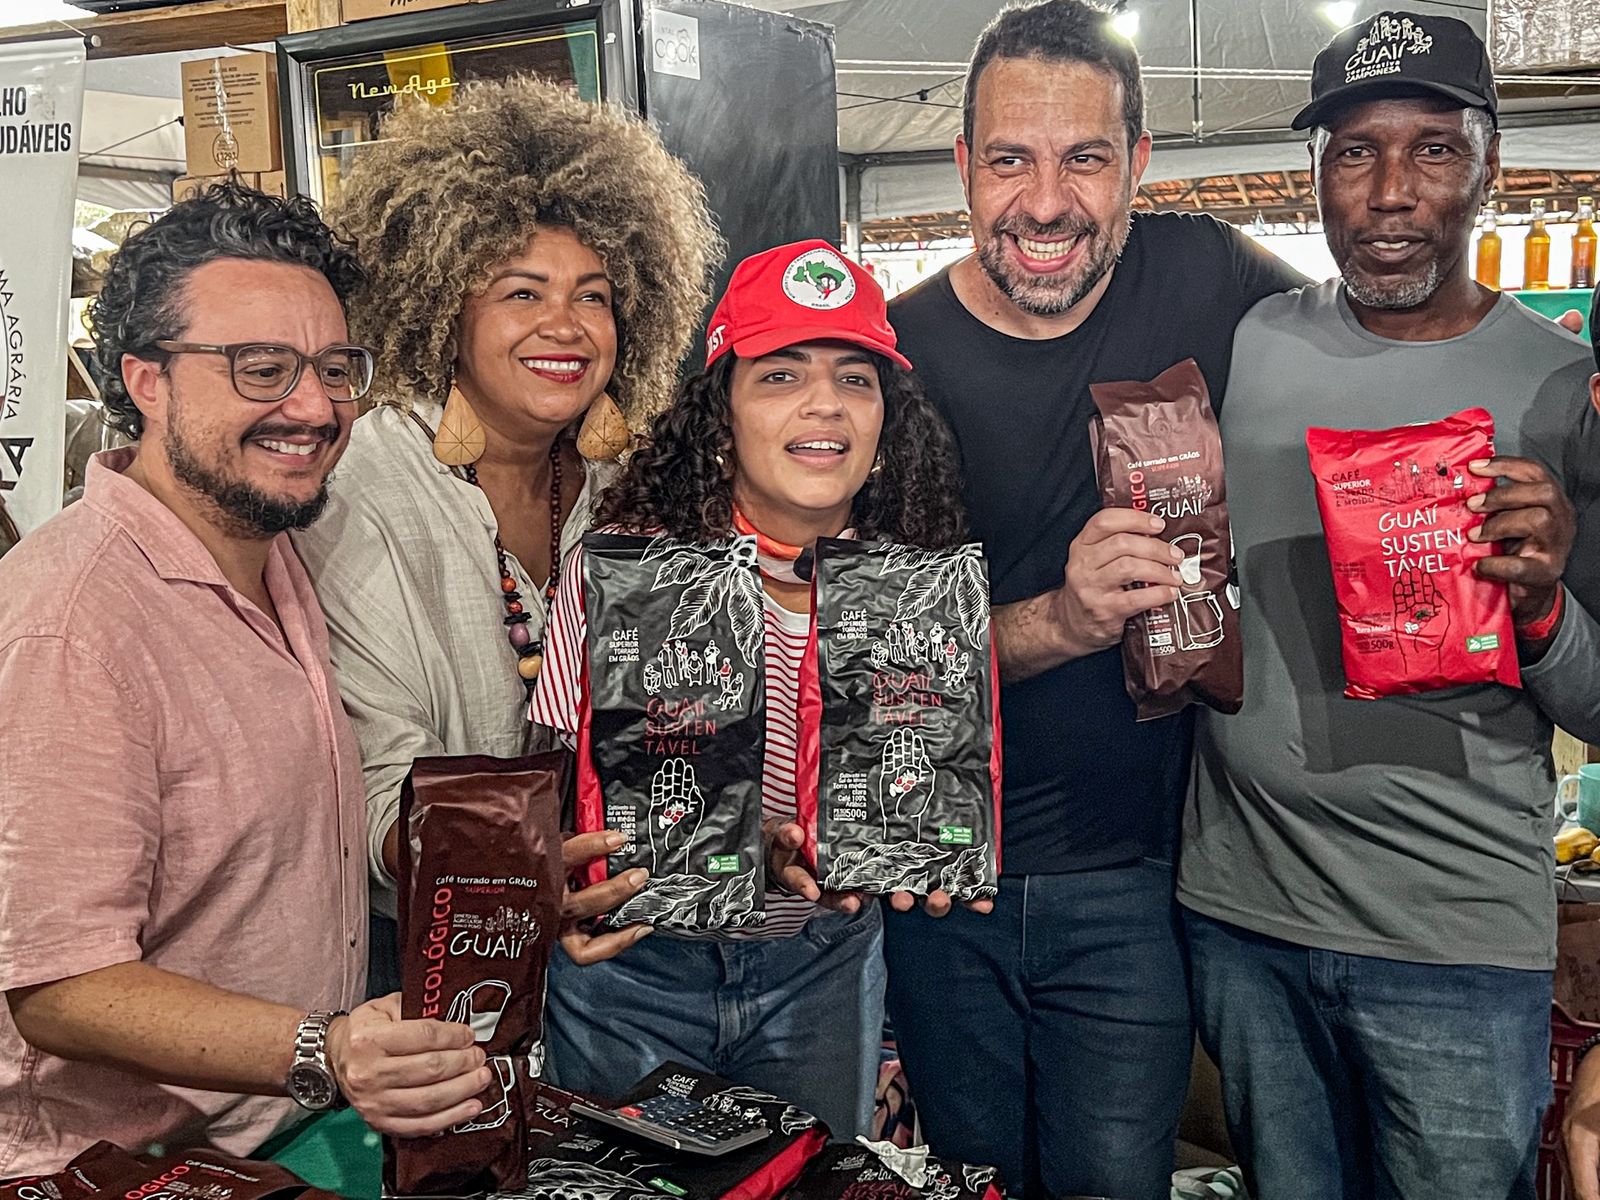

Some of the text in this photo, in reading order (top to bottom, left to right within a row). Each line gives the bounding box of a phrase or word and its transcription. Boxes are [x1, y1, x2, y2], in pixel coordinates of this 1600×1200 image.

[1345, 65, 1401, 83] CAMPONESA
[347, 74, 459, 99] New Age
[0, 86, 26, 116] HO
[6, 314, 27, 420] AGRÁRIA
[1333, 479, 1371, 490] SUPERIOR
[1381, 527, 1462, 556] SUSTEN
[1383, 554, 1450, 578] TÁVEL
[841, 608, 867, 621] CAFÉ
[612, 627, 639, 641] CAFÉ
[872, 690, 943, 708] SUSTEN
[645, 719, 717, 737] SUSTEN
[846, 808, 867, 821] 500g
[436, 875, 454, 886] Café
[456, 876, 490, 885] torrado
[508, 877, 538, 888] GRÃOS
[422, 888, 453, 1018] ECOLÓGICO
